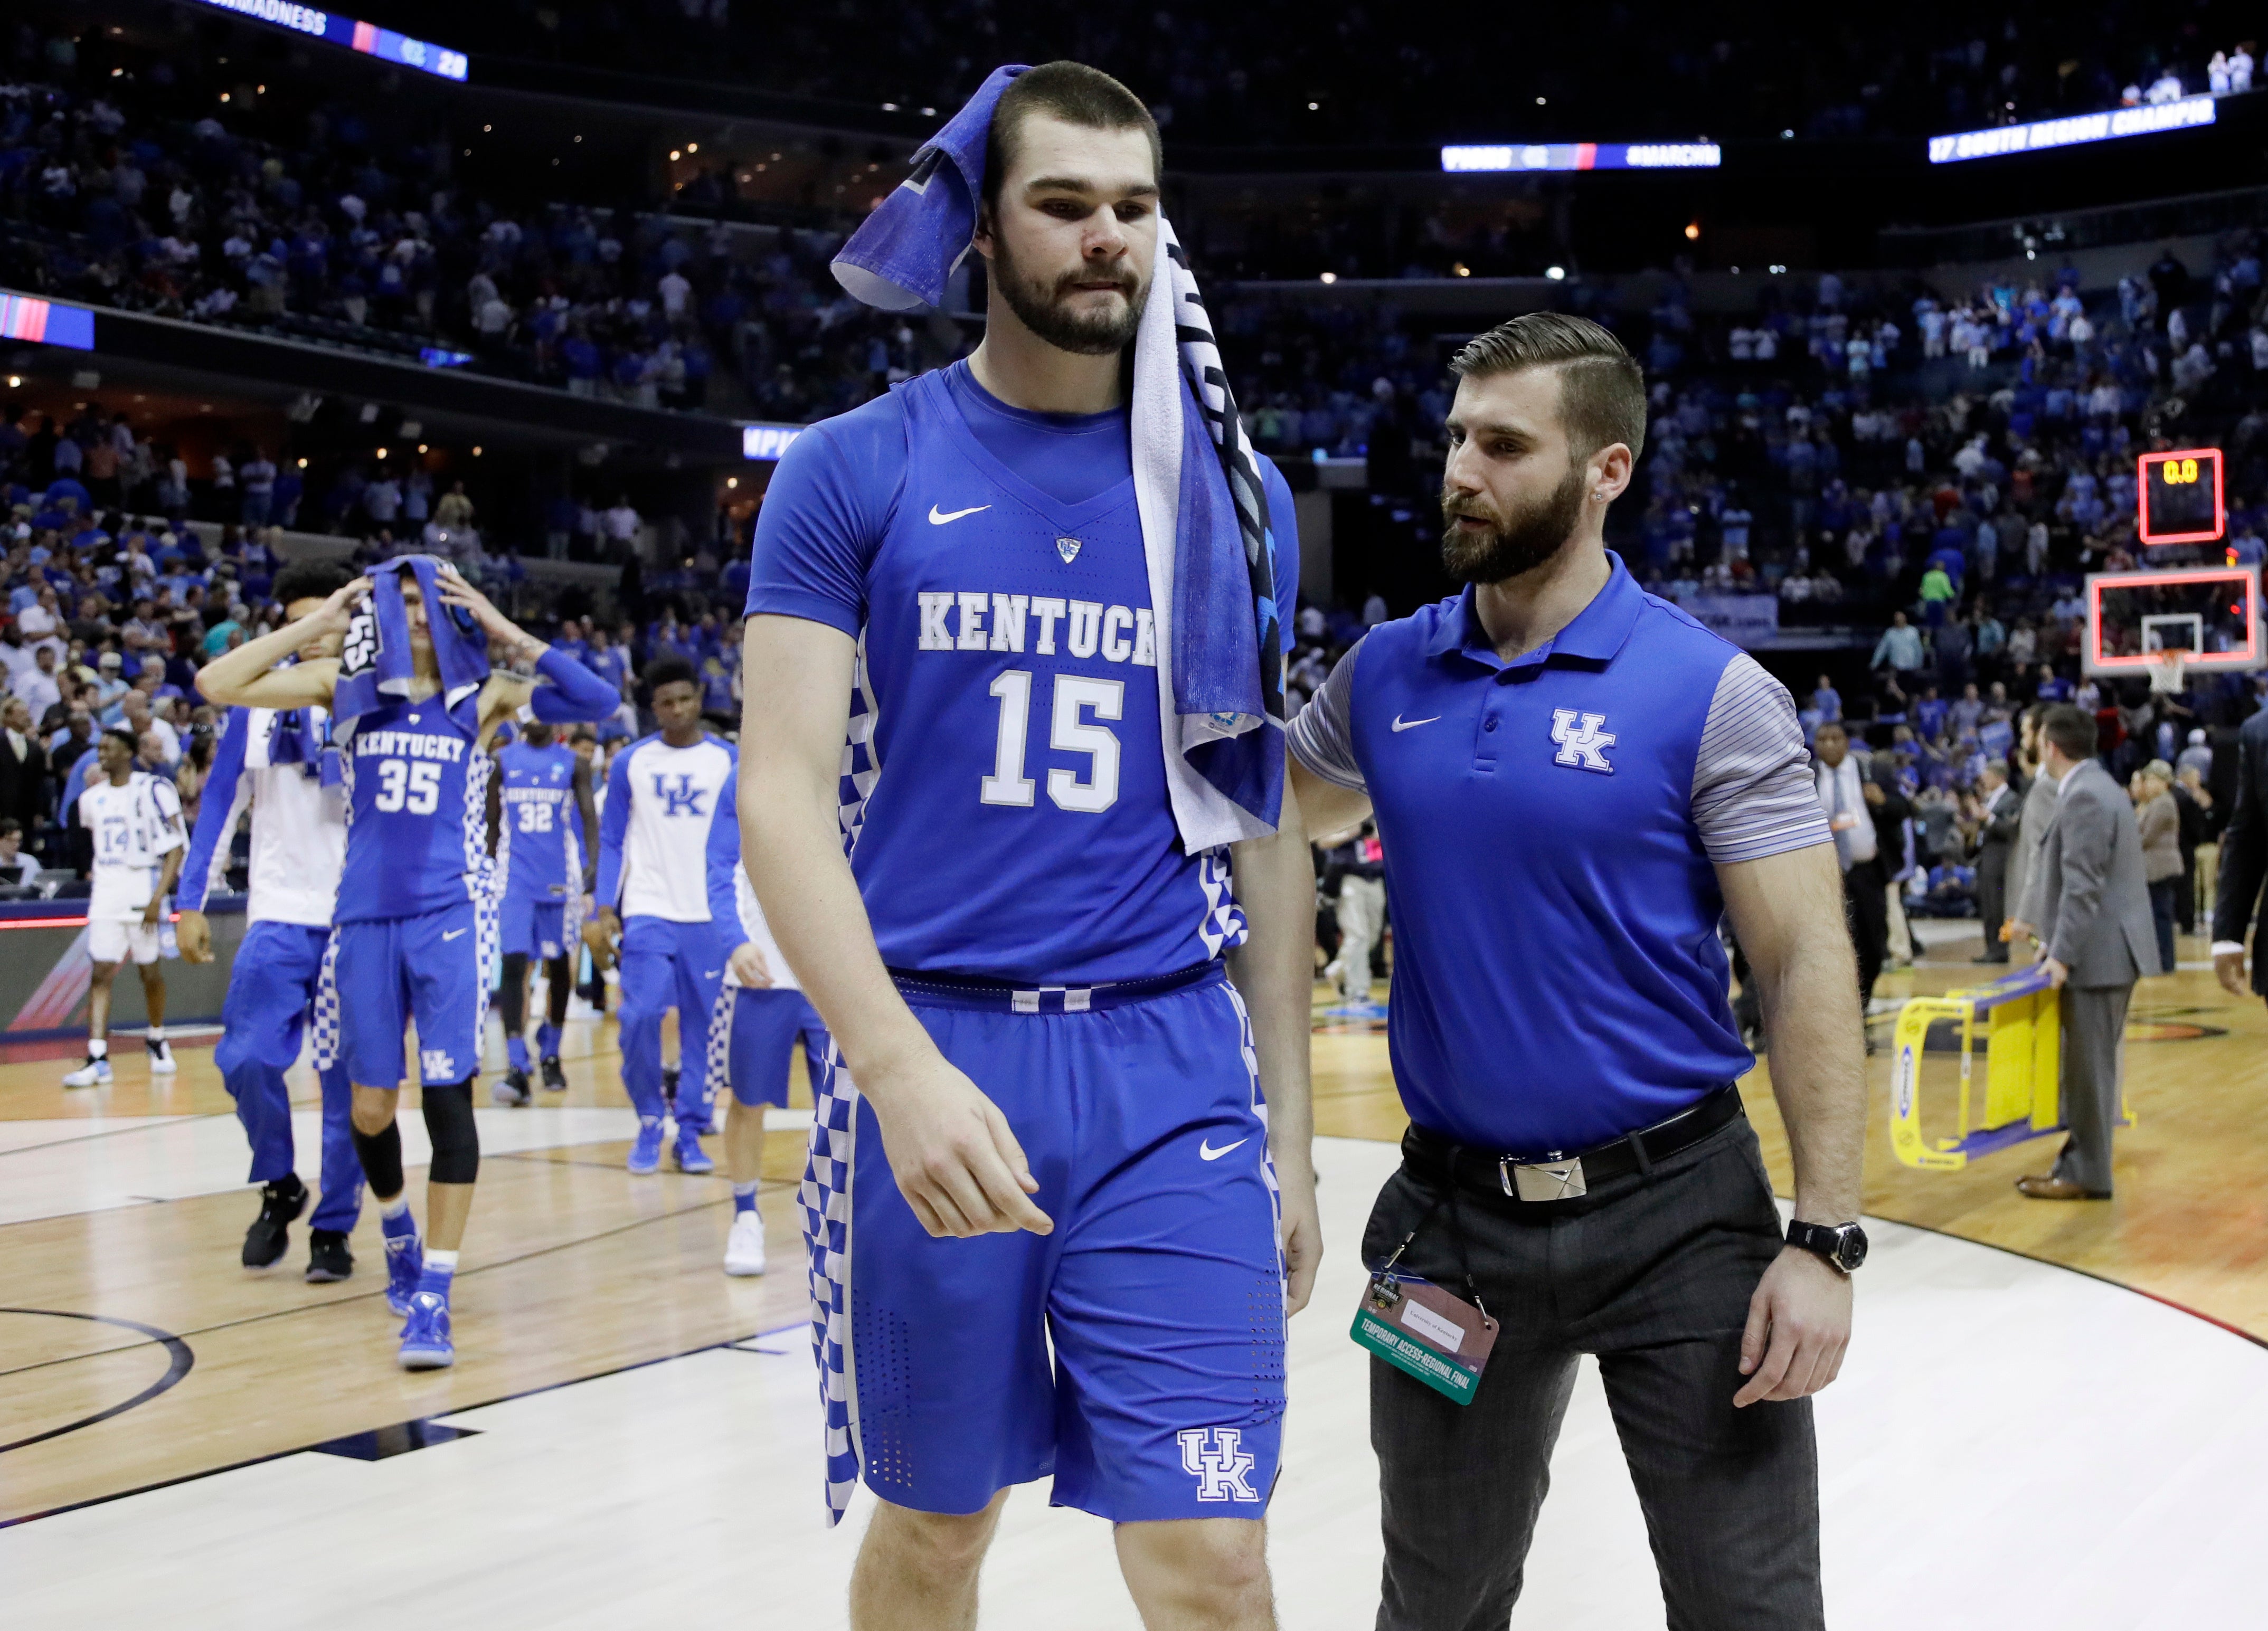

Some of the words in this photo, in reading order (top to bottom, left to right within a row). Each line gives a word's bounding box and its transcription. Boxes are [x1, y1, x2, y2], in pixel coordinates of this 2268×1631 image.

[1957, 126, 2028, 158] SOUTH
[2029, 114, 2109, 148] REGION
[2163, 458, 2198, 485] 0.0
[356, 731, 466, 763] KENTUCKY
[980, 669, 1125, 813] 15
[1551, 708, 1616, 772] UK
[374, 758, 443, 816] 35
[650, 773, 708, 817] UK
[517, 802, 553, 833] 32
[1373, 1283, 1399, 1302] REGIONAL
[1410, 1311, 1431, 1326] University
[1361, 1318, 1400, 1347] TEMPORARY
[1450, 1370, 1470, 1389] FINAL
[1177, 1427, 1260, 1502] UK
